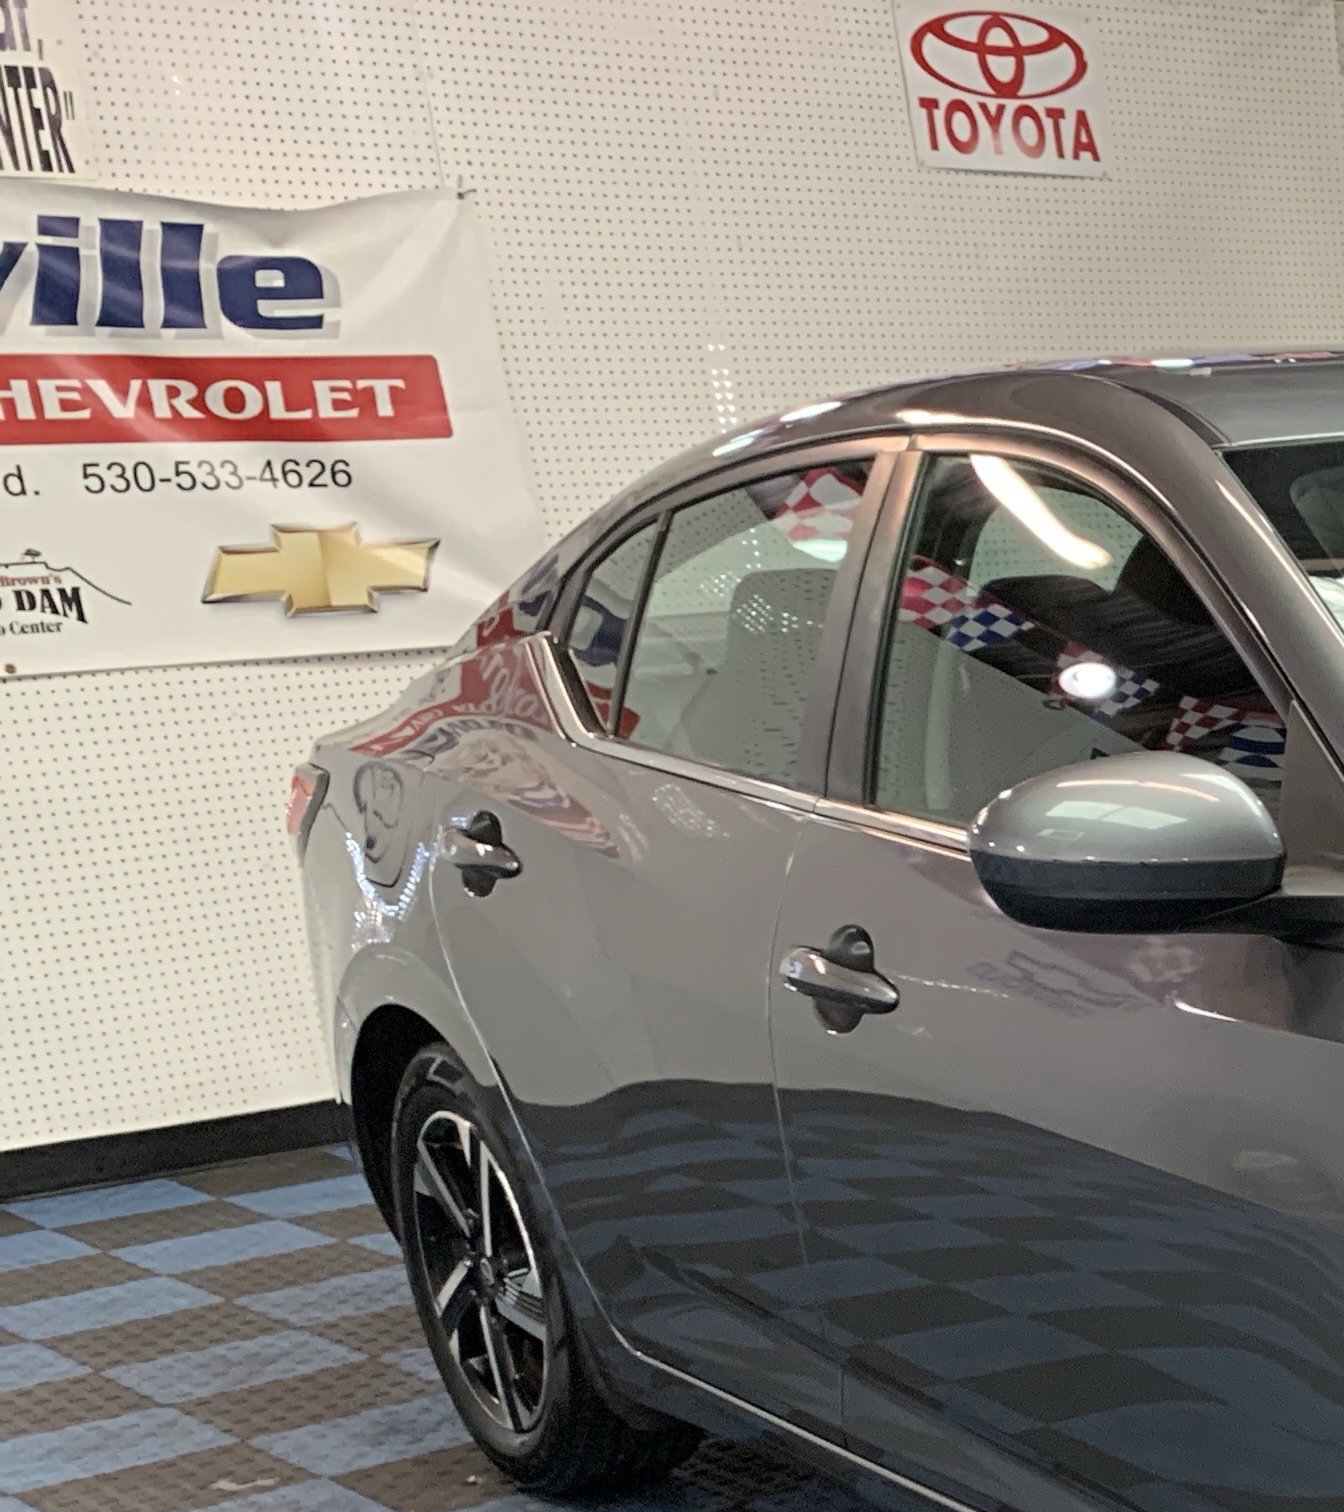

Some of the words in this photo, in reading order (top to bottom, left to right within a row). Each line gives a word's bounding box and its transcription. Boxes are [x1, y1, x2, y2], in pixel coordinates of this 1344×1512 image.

[917, 96, 1101, 163] TOYOTA
[81, 458, 354, 495] 530-533-4626
[12, 586, 88, 624] DAM
[9, 620, 63, 636] Center
